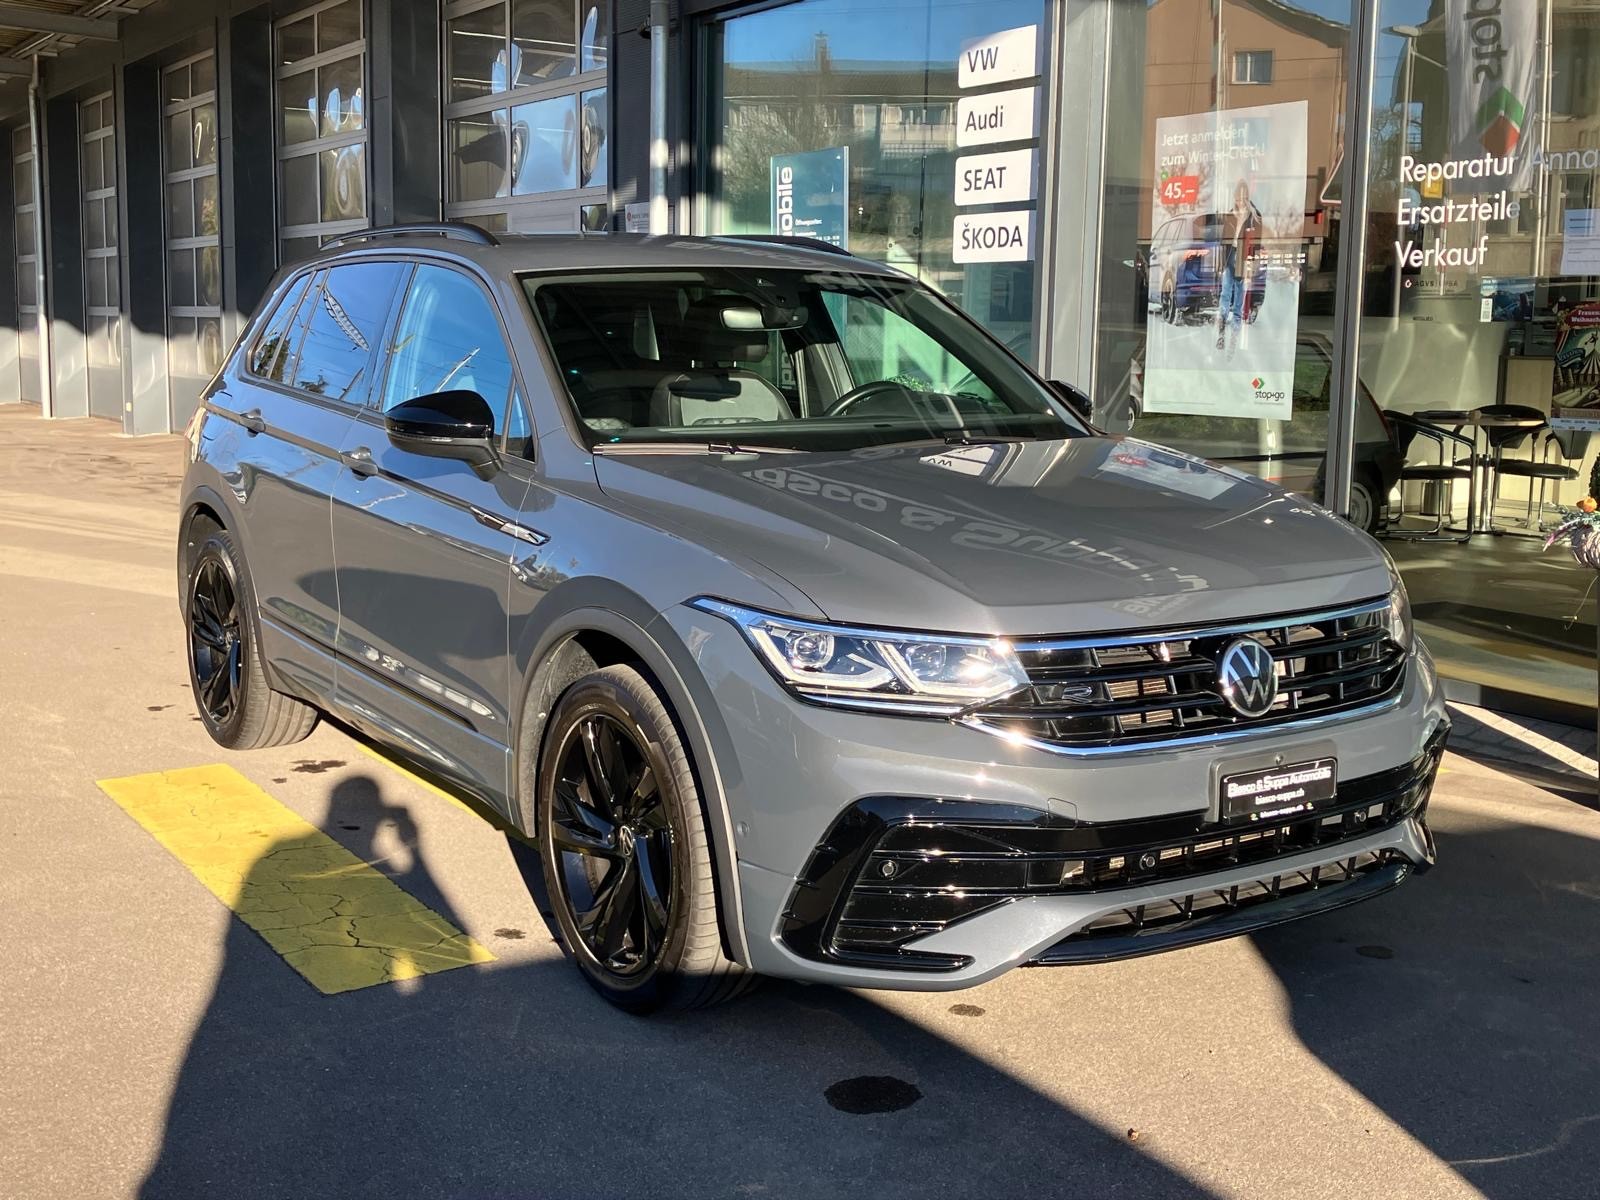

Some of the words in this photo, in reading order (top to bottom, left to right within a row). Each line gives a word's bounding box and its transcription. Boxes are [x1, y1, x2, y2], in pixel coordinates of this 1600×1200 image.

[967, 46, 999, 73] VW
[965, 105, 1004, 132] Audi
[1162, 134, 1189, 147] Jetzt
[1161, 154, 1185, 167] zum
[1399, 152, 1518, 188] Reparatur
[963, 166, 1007, 192] SEAT
[1397, 190, 1521, 225] Ersatzteile
[961, 223, 1023, 250] ŠKODA
[1395, 236, 1489, 268] Verkauf
